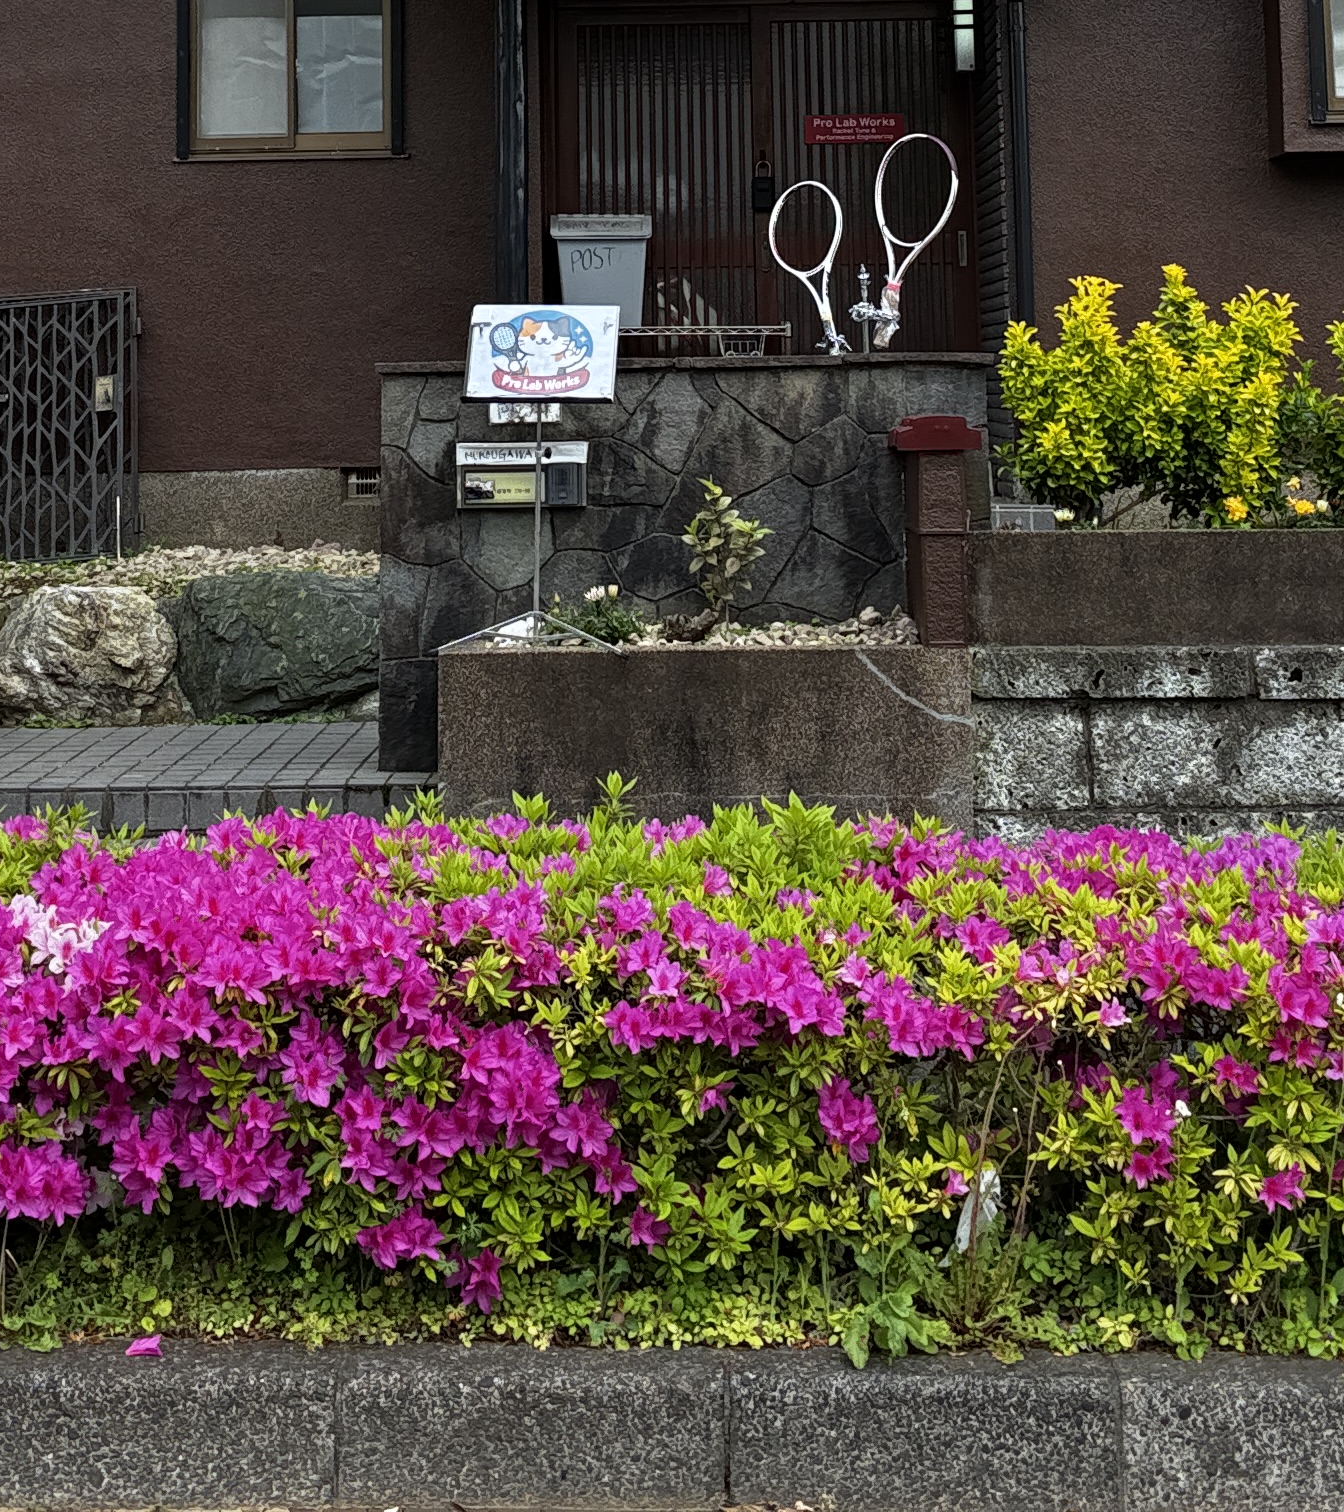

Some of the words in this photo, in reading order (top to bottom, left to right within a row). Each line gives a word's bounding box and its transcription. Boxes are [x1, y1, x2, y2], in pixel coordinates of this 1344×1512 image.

[813, 118, 833, 127] Pro
[836, 118, 857, 127] Lab
[859, 117, 895, 127] Works
[570, 247, 616, 275] POST
[501, 375, 522, 388] Pro
[522, 379, 543, 391] Lab
[543, 376, 580, 391] Works
